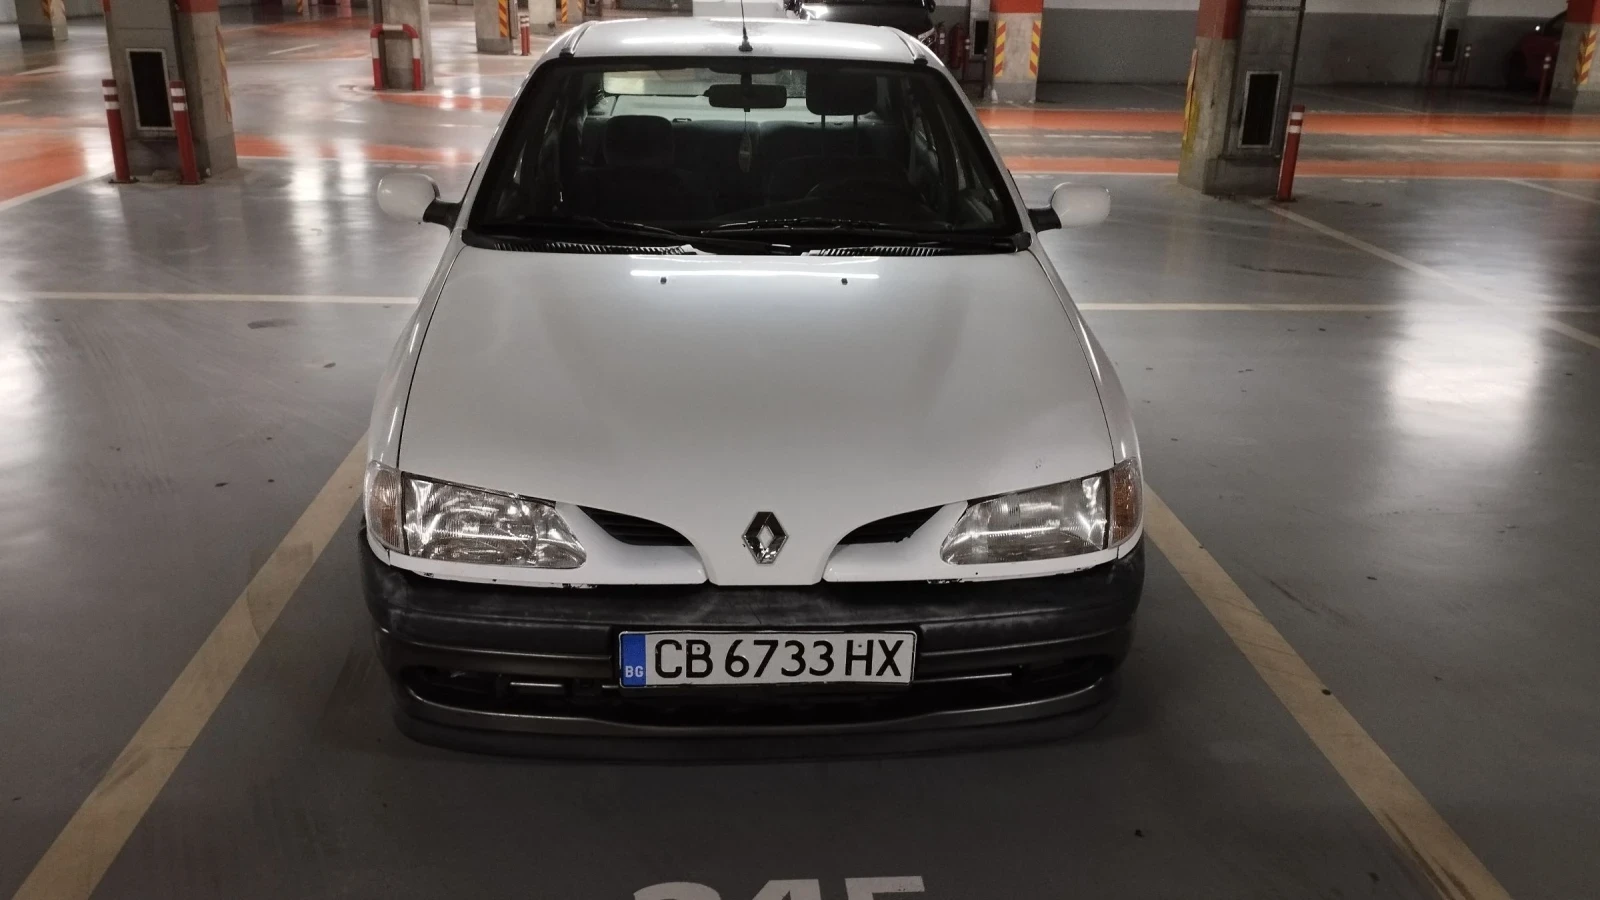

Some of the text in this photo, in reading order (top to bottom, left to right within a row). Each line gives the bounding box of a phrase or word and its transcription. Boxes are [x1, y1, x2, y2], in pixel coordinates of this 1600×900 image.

[624, 665, 644, 678] BG
[654, 639, 904, 679] CB 6733 HX
